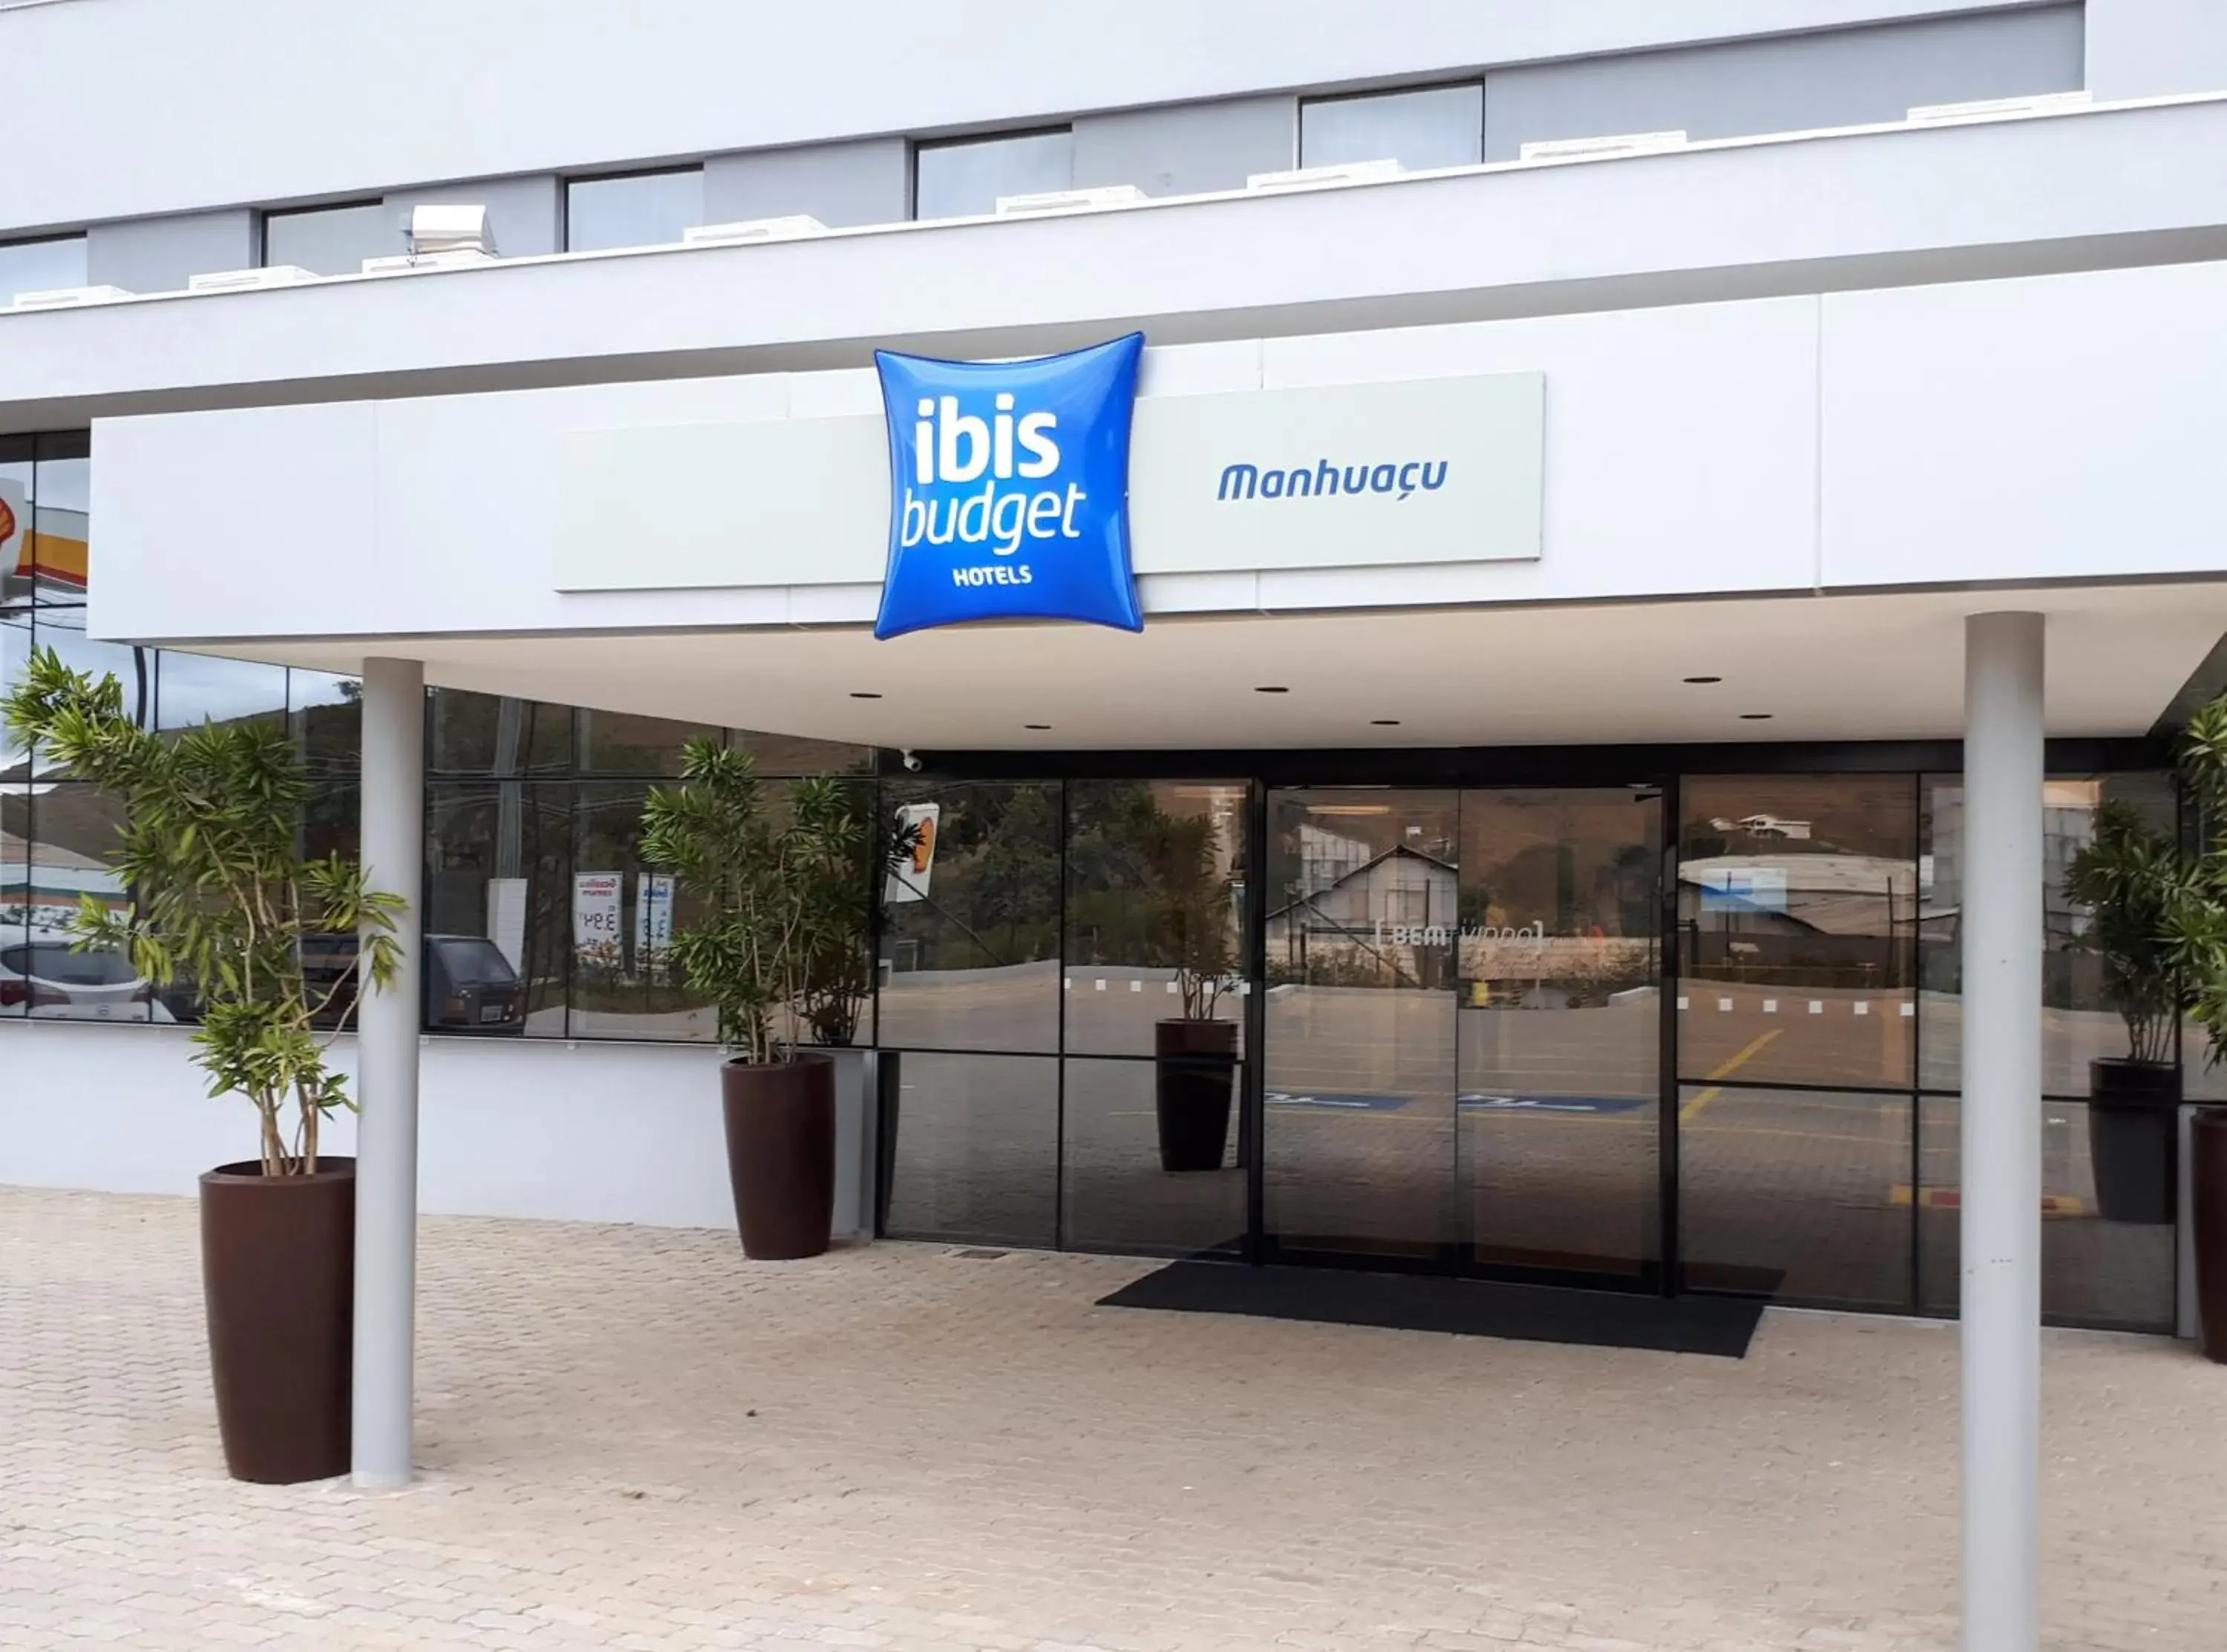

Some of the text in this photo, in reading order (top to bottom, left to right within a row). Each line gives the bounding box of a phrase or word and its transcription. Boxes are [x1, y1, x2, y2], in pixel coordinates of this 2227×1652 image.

[915, 392, 1061, 485] ibis
[1217, 459, 1448, 502] Manhuaçu
[900, 479, 1086, 556] budget
[952, 565, 1033, 587] HOTELS
